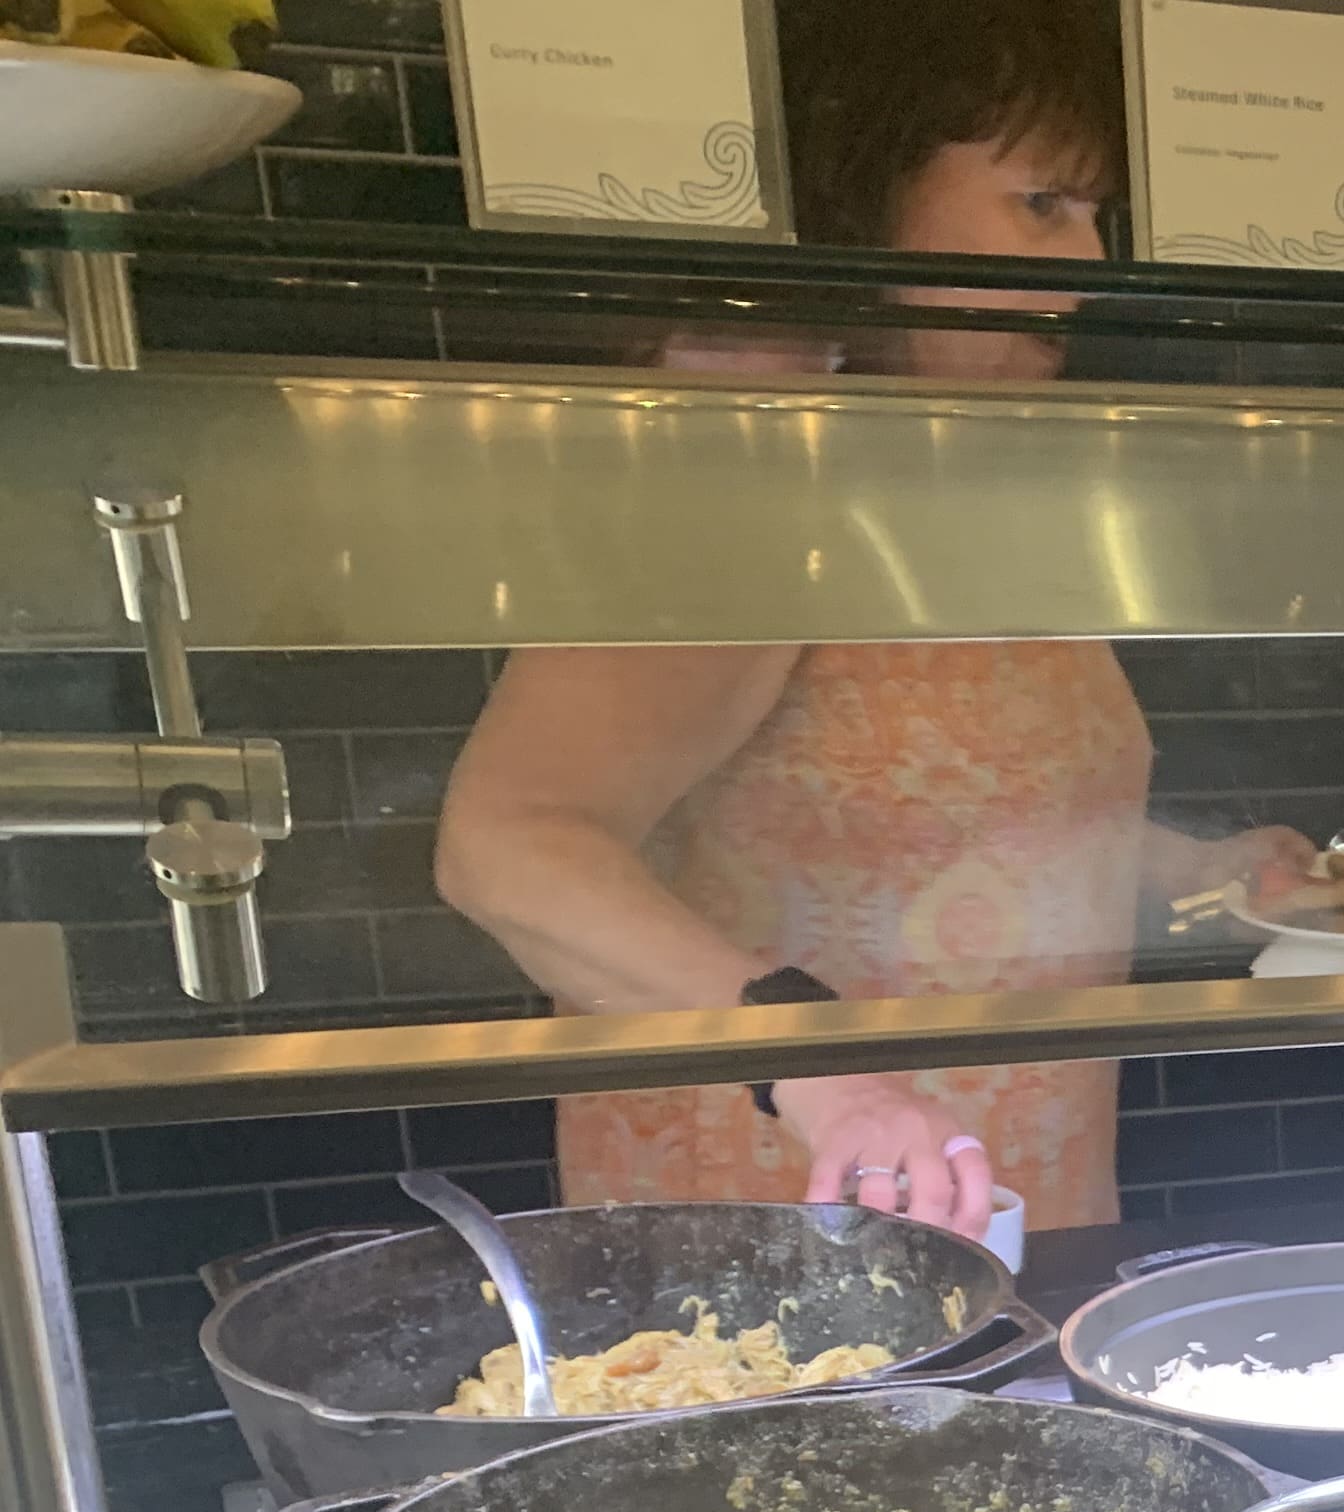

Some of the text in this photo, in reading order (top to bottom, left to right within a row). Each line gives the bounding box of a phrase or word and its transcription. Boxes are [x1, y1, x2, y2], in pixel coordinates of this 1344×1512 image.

[489, 43, 615, 68] Curry Chicken
[1172, 86, 1325, 112] Steamed White Rice
